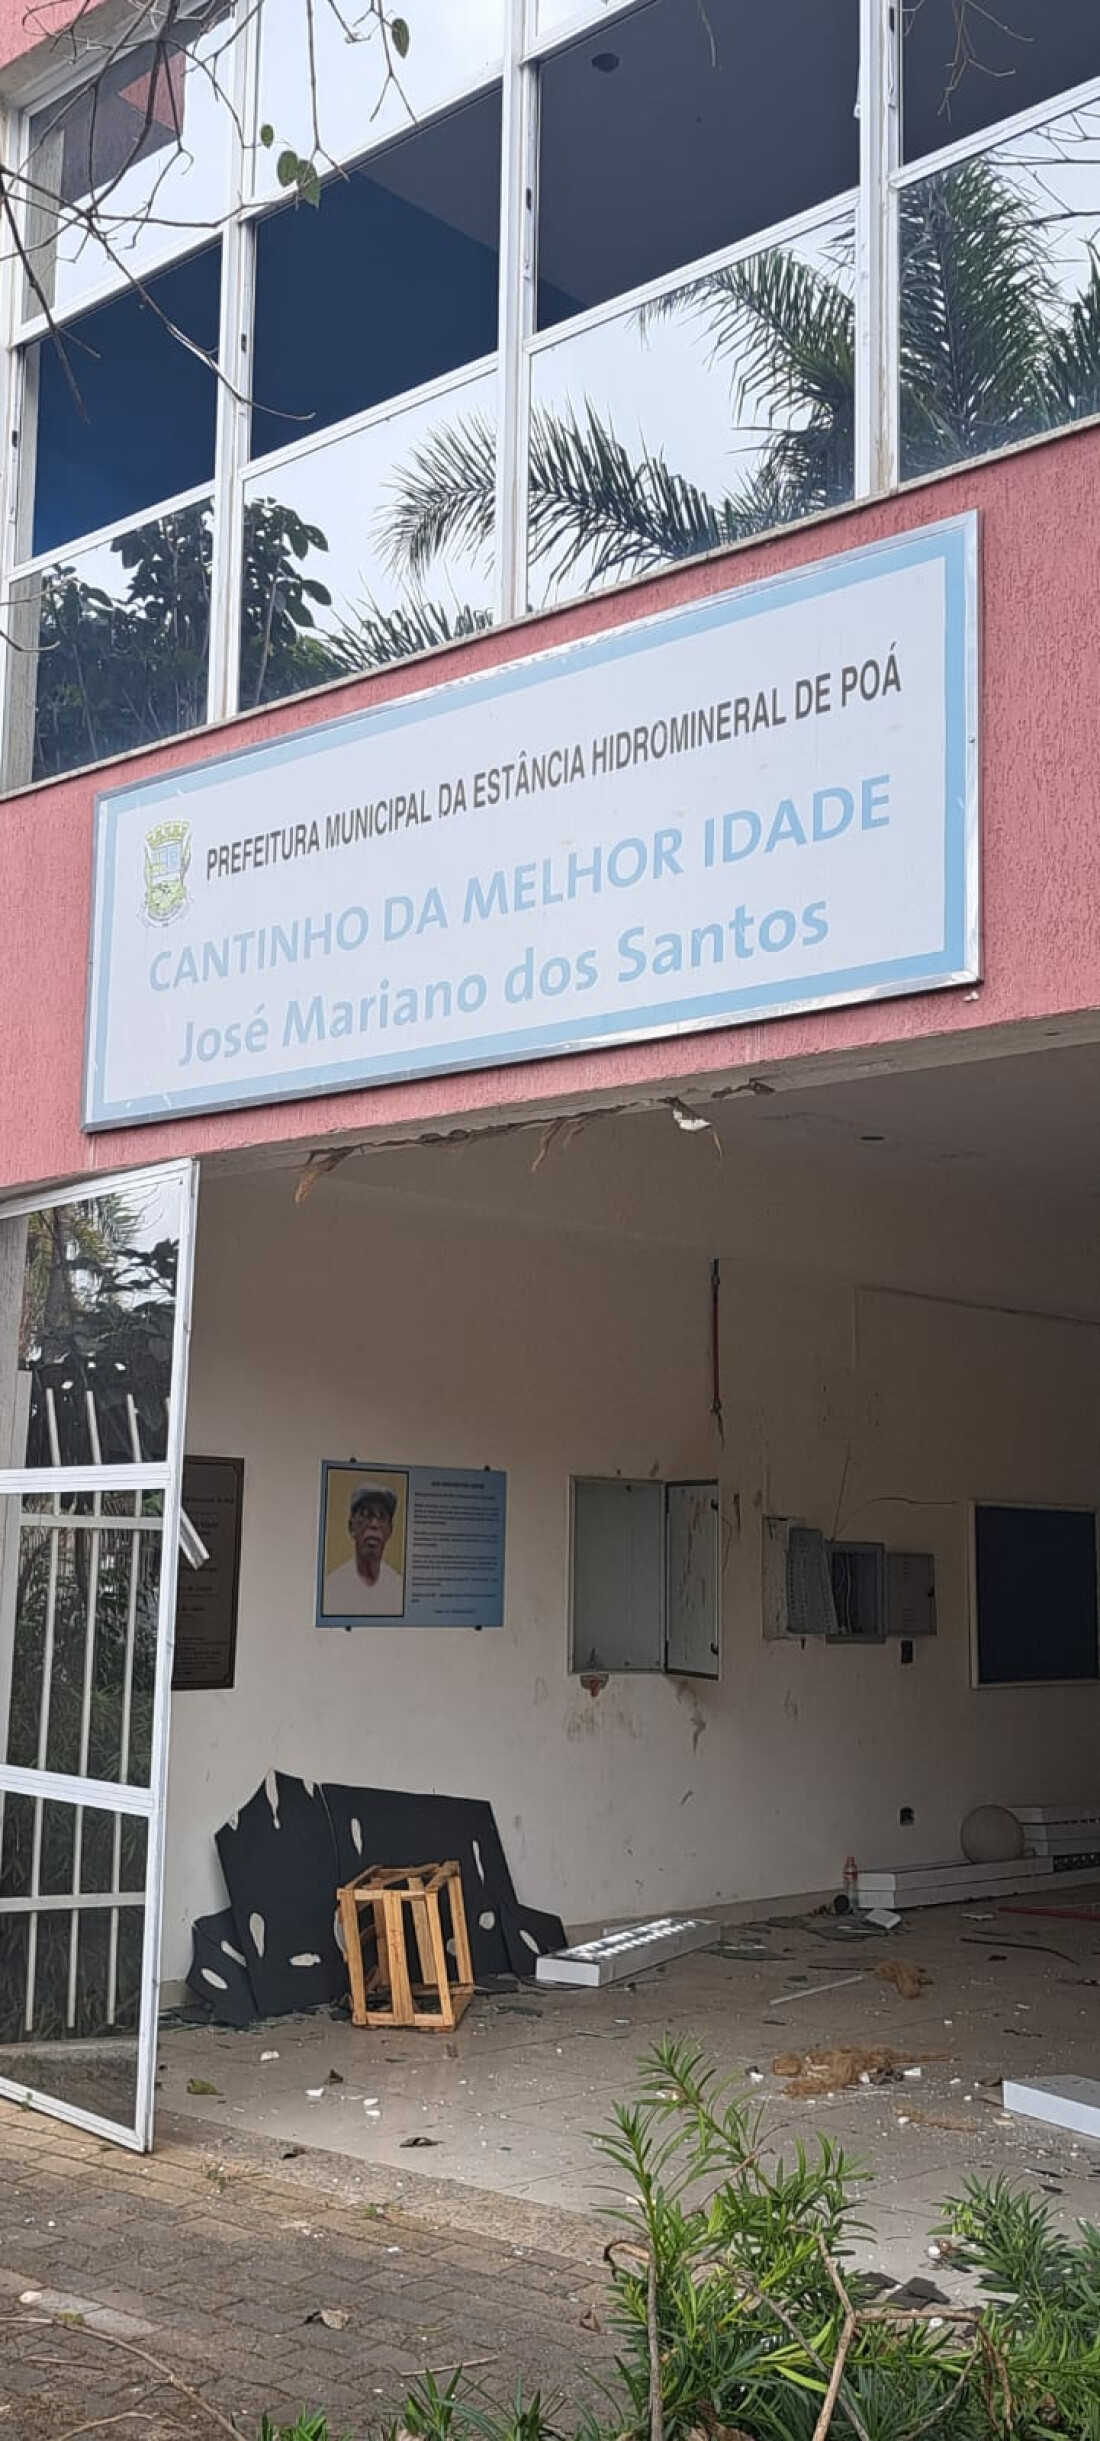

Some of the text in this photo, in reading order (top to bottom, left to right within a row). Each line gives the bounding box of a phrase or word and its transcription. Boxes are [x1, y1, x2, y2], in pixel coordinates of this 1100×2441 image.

[206, 640, 904, 882] PREFEITURA MUNICIPAL DA ESTÂNCIA HIDROMINERAL DE POÁ
[149, 774, 891, 992] CANTINHO DA MELHOR IDADE
[178, 900, 829, 1067] José Mariano dos Santos
